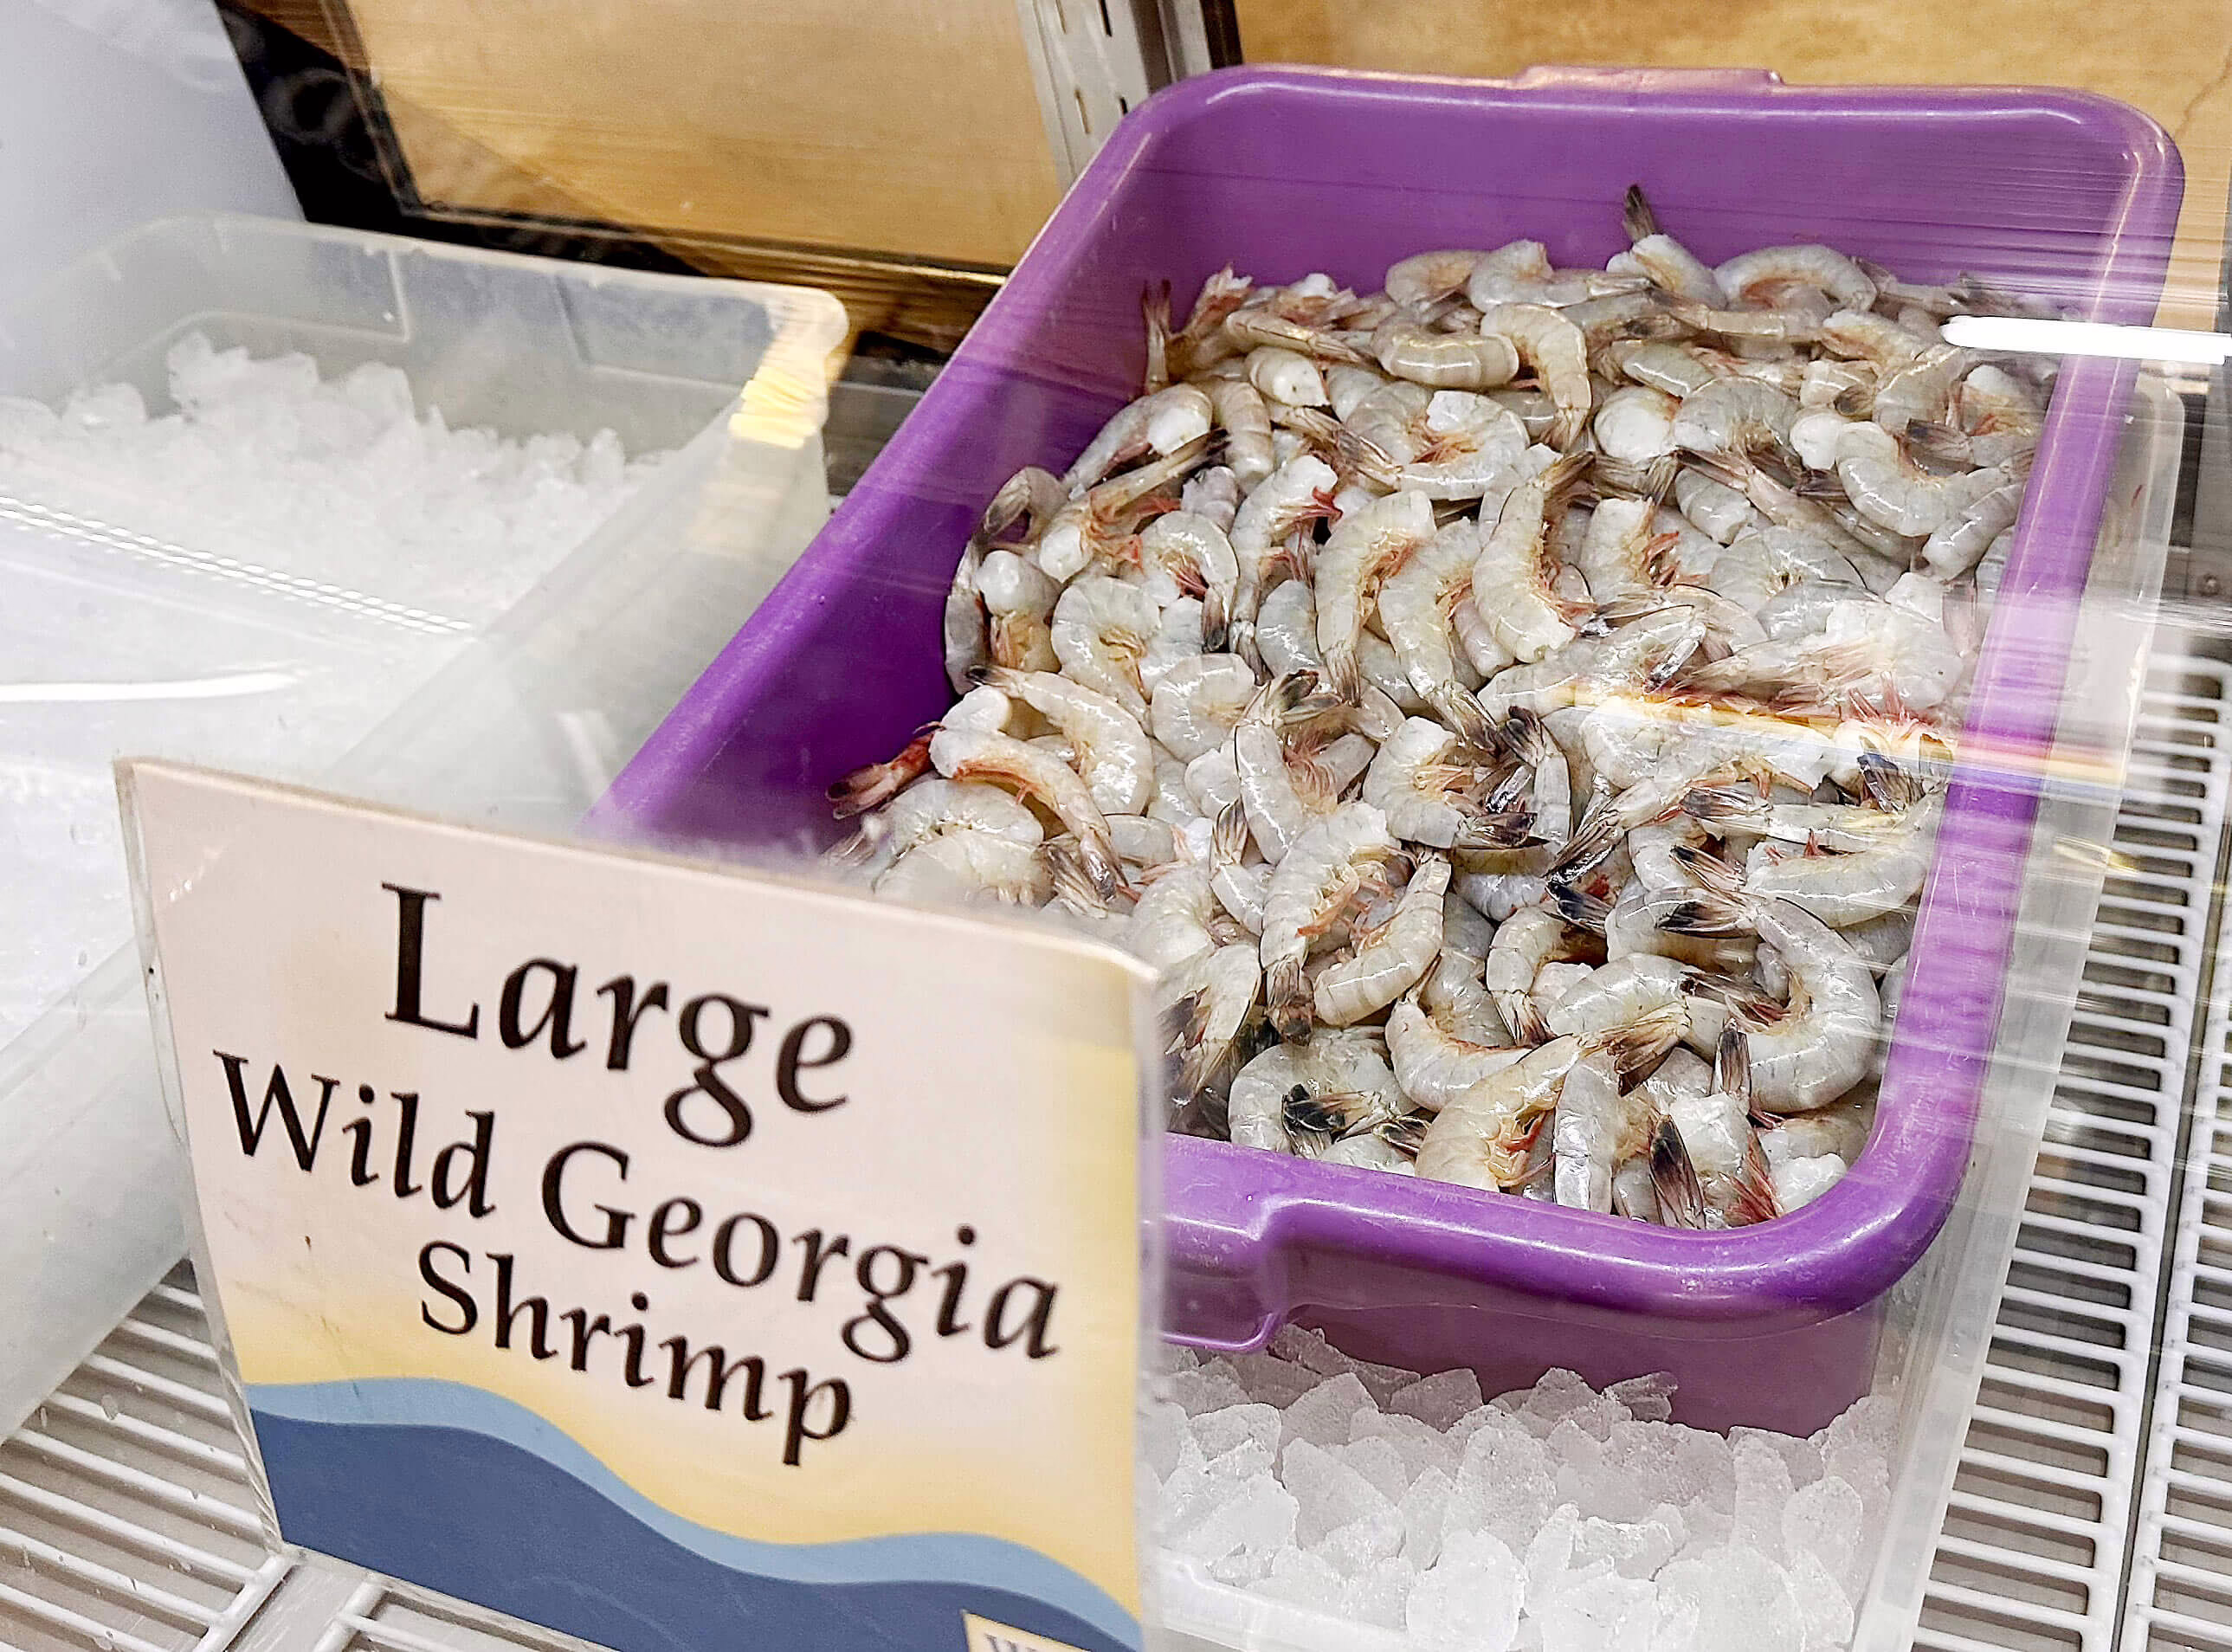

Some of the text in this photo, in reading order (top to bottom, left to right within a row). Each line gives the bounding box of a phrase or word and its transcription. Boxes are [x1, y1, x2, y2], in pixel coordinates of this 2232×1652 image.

[382, 882, 854, 1148] Large
[212, 1049, 1059, 1364] Wild Georgia
[418, 1240, 852, 1468] Shrimp
